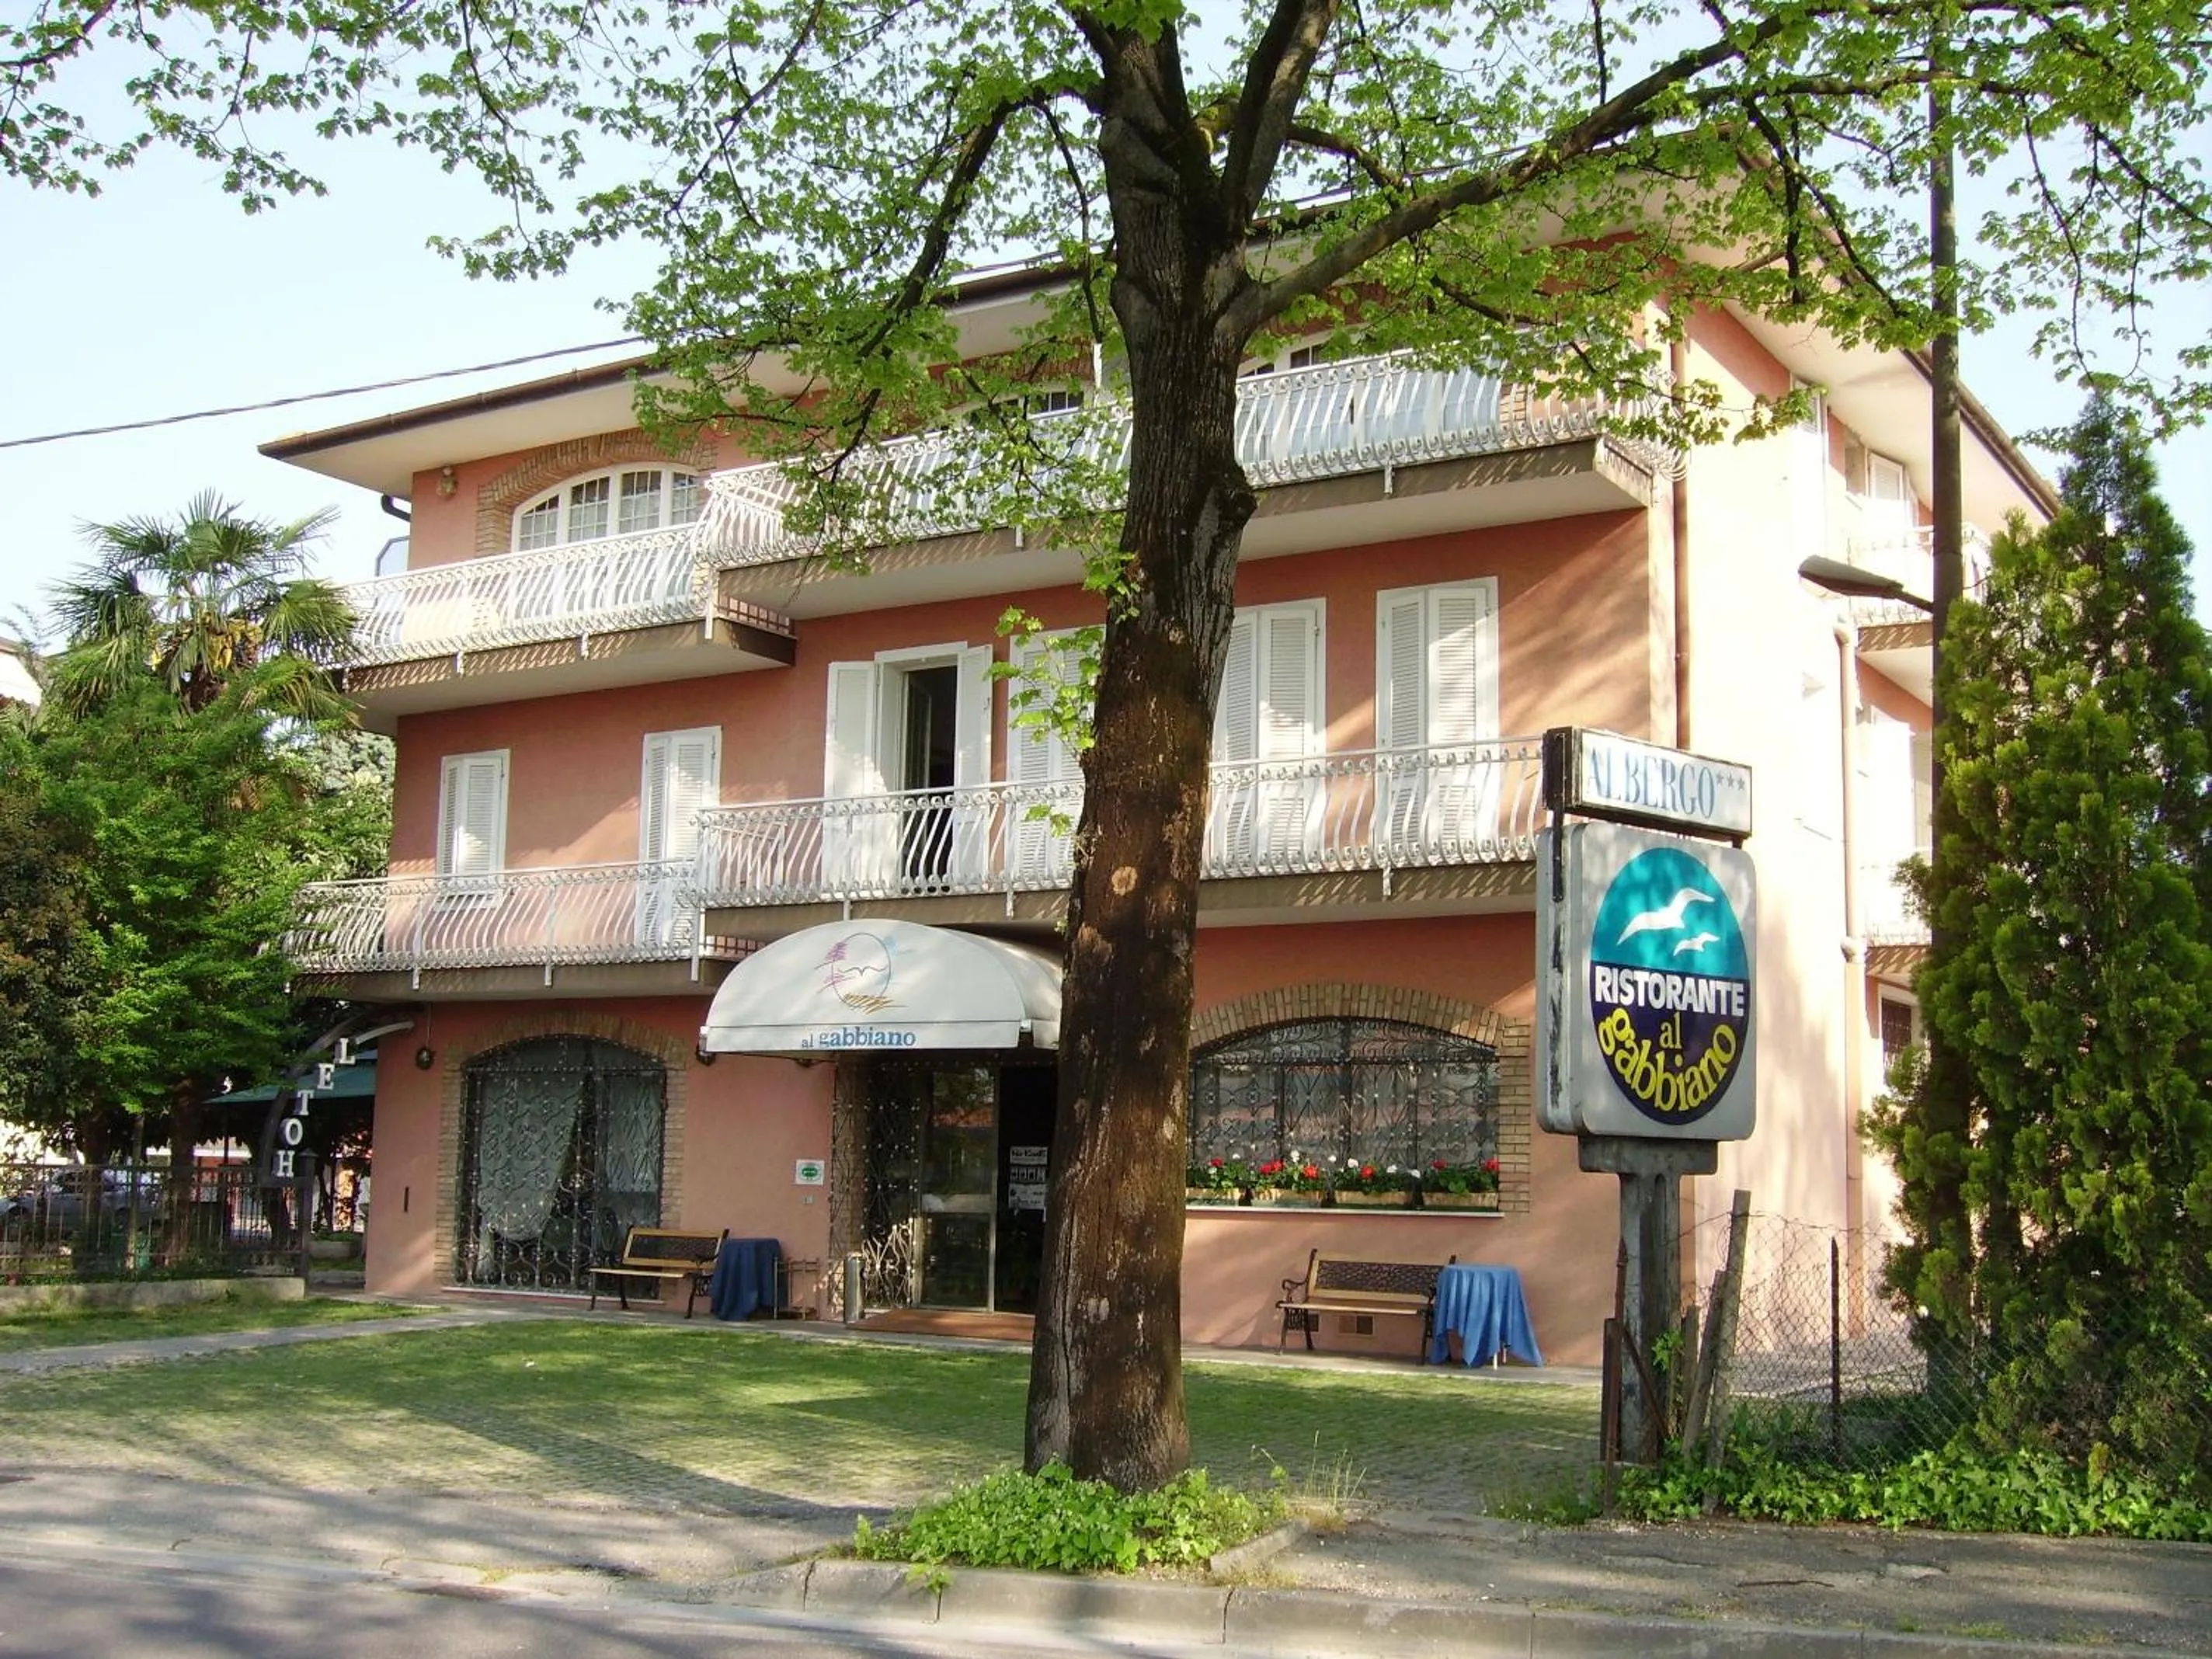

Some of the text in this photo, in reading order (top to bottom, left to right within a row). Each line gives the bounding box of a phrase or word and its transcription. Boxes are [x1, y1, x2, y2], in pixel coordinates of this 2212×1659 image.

[1586, 746, 1715, 819] ALBERGO
[1595, 965, 1745, 1017] RISTORANTE
[802, 1027, 916, 1049] al gabbiano
[1598, 1007, 1737, 1111] gabbiano
[1660, 1011, 1682, 1049] al
[276, 1038, 356, 1177] HOTEL
